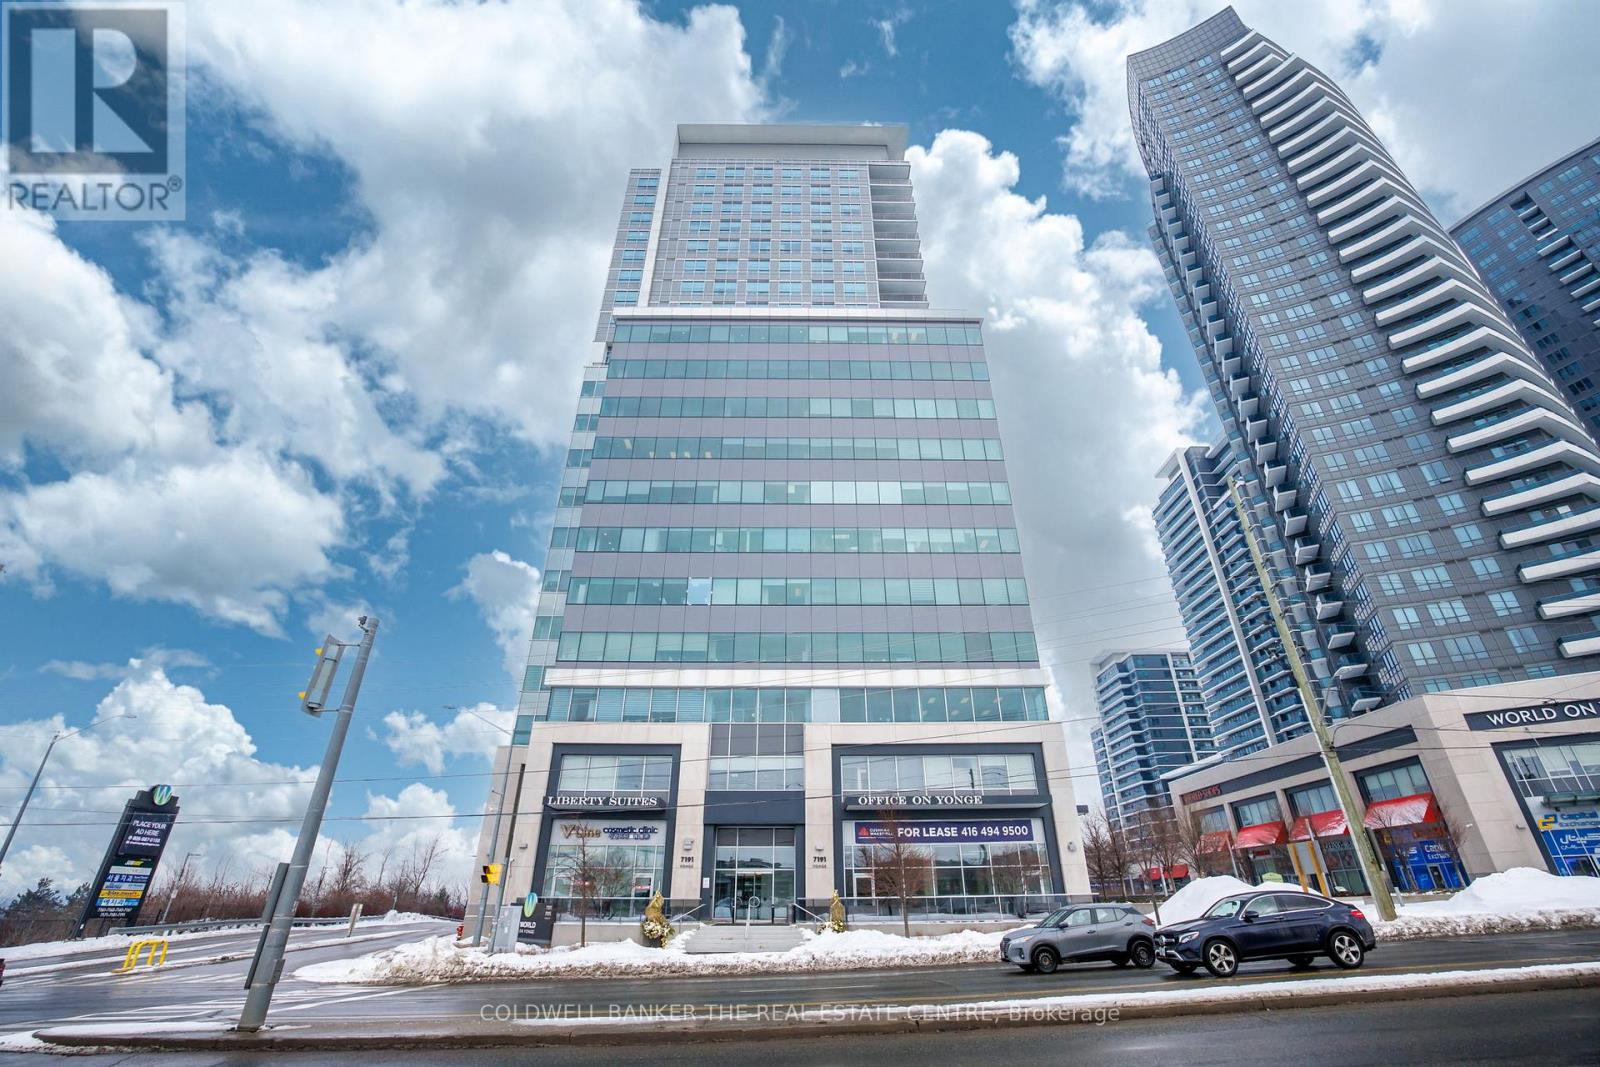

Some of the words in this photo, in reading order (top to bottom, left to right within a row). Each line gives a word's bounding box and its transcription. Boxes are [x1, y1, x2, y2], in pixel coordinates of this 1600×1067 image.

[1486, 707, 1557, 726] WORLD
[1563, 702, 1597, 718] ON
[547, 796, 607, 806] LIBERTY
[608, 796, 658, 806] SUITES
[858, 796, 907, 806] OFFICE
[912, 796, 933, 805] ON
[935, 795, 983, 805] YONGE
[133, 820, 151, 828] PLACE
[897, 827, 920, 838] FOR
[922, 827, 958, 837] LEASE
[961, 827, 978, 837] 416
[980, 826, 1000, 836] 494
[1002, 825, 1029, 836] 9500
